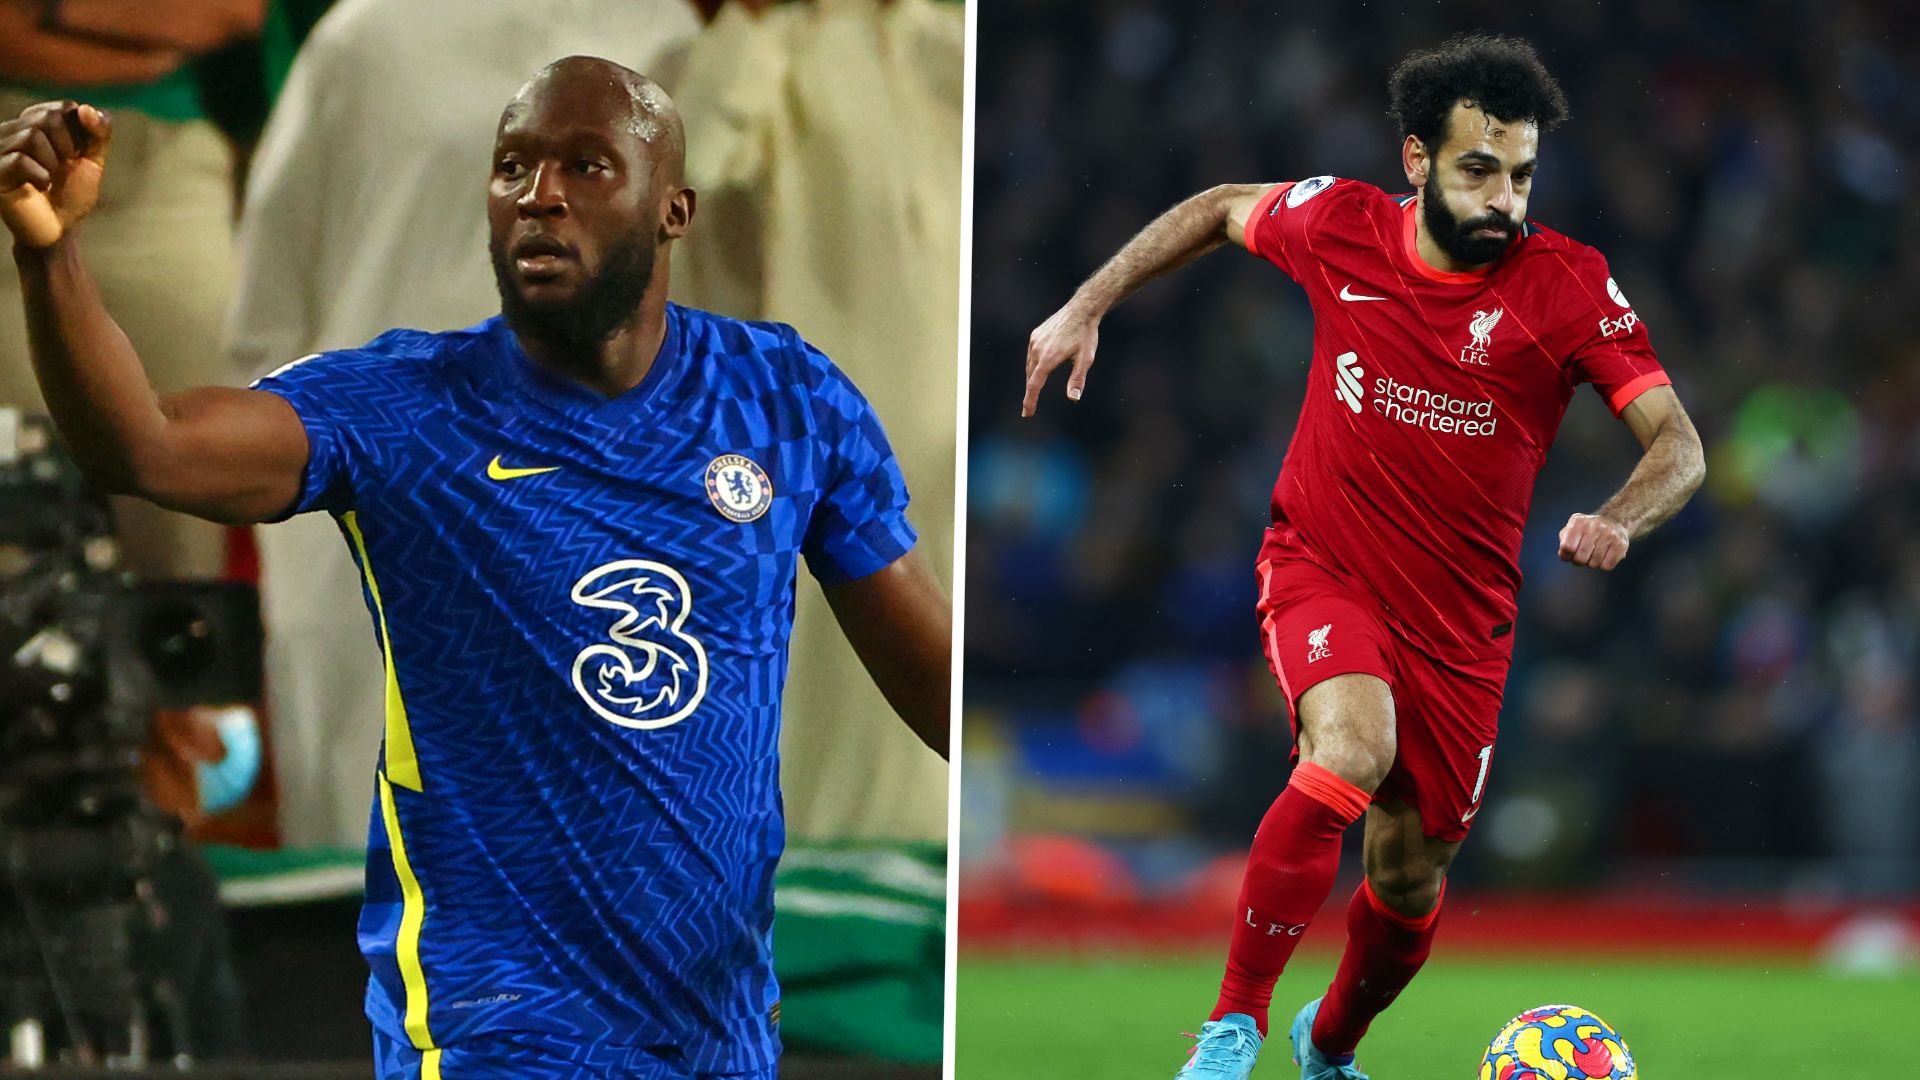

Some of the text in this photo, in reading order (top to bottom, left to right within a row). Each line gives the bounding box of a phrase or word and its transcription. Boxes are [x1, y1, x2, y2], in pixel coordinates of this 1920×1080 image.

[1599, 310, 1640, 337] Exp
[1373, 397, 1497, 436] chartered
[1374, 377, 1493, 418] standard
[711, 457, 752, 473] CHELSEA
[571, 559, 708, 729] 3
